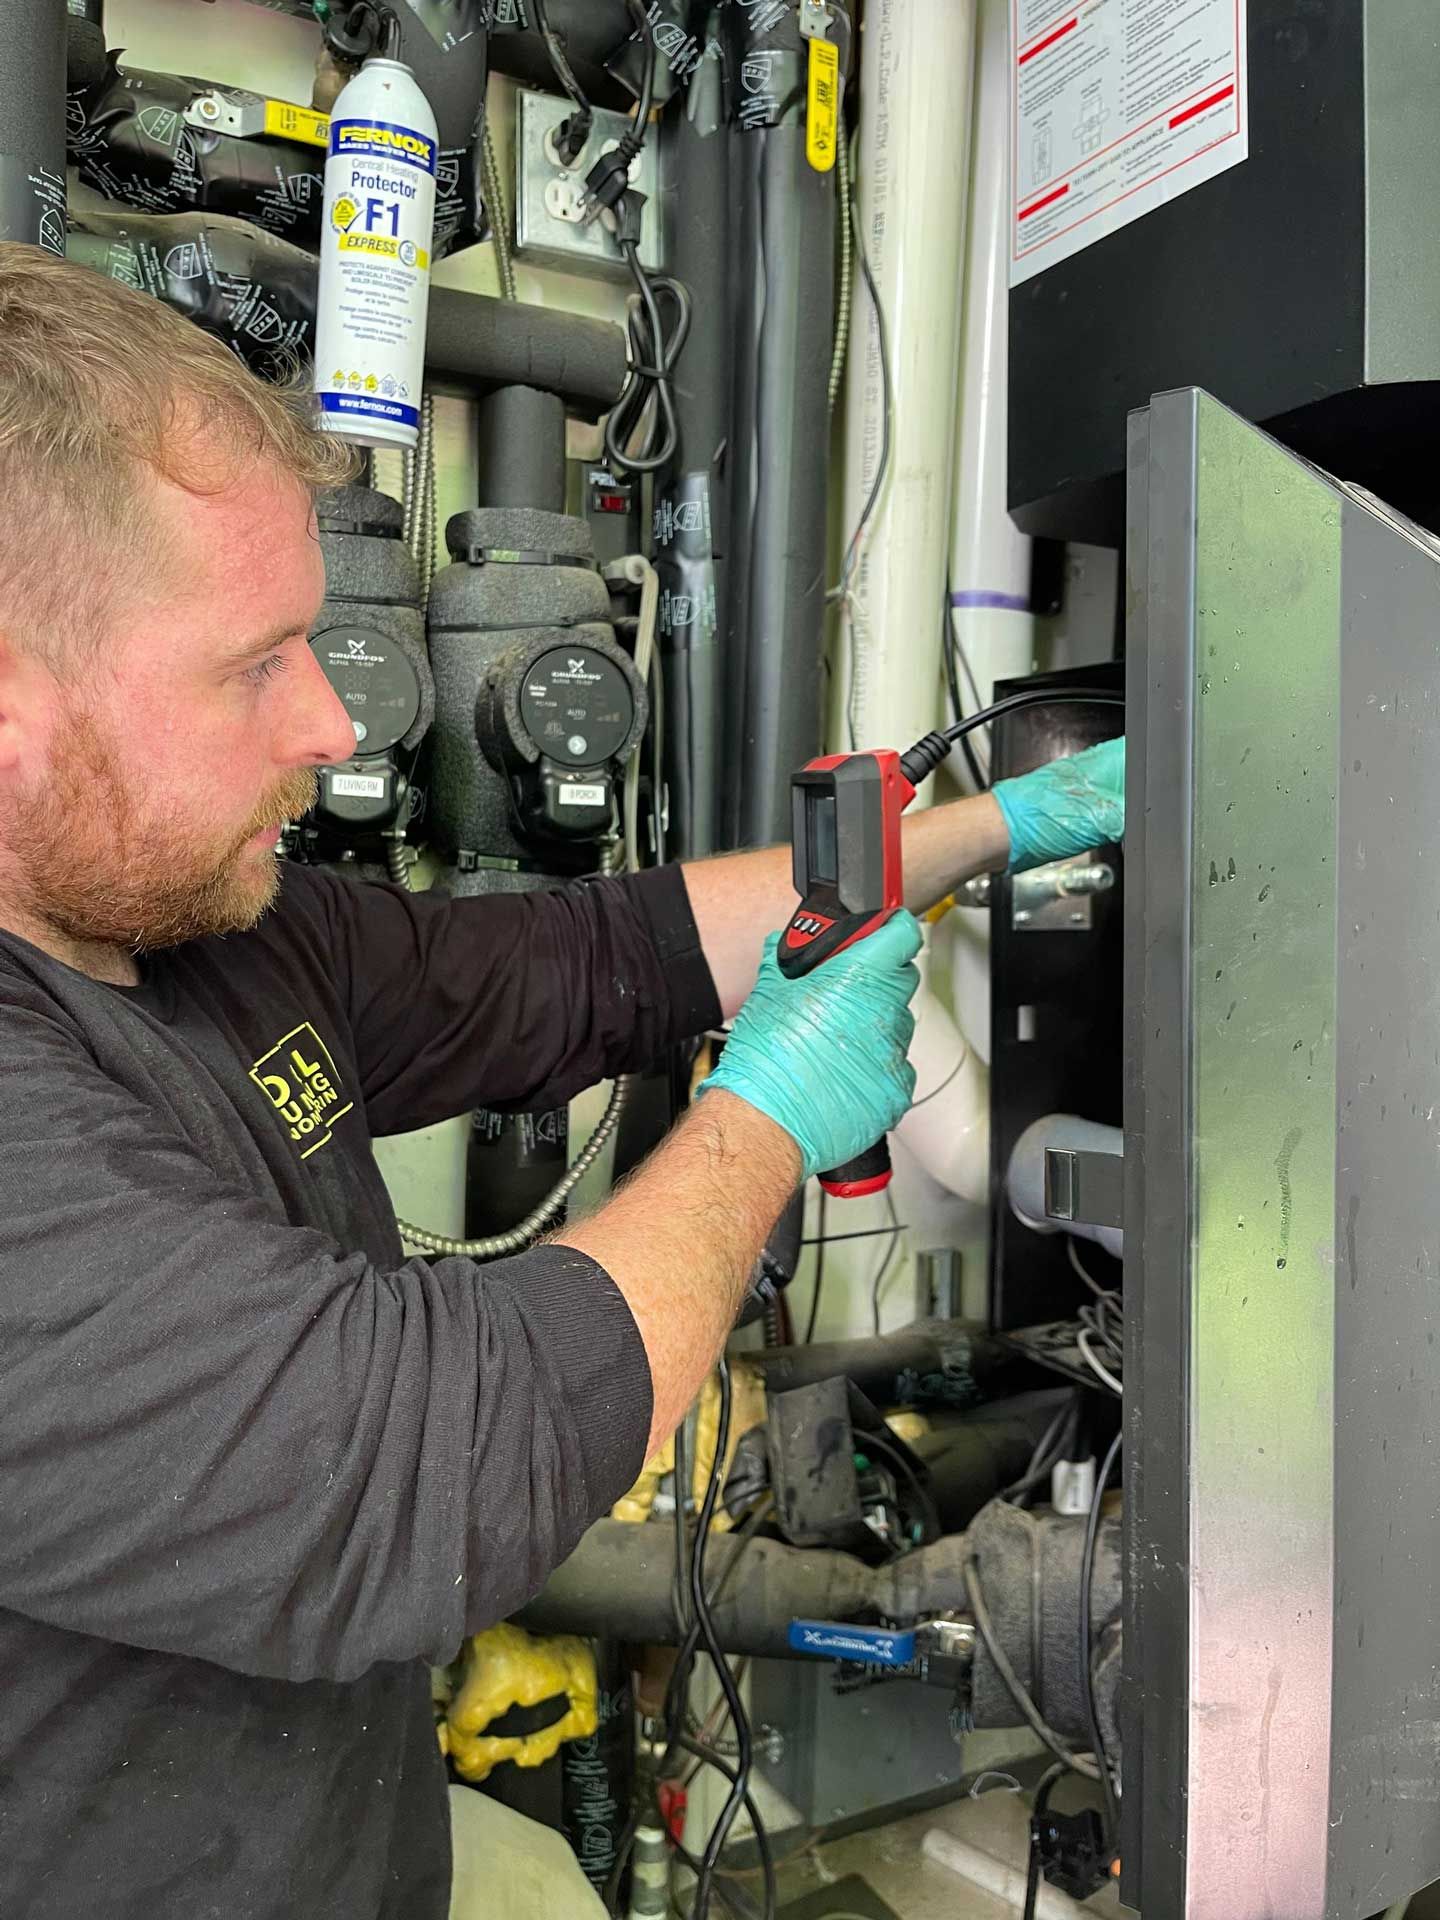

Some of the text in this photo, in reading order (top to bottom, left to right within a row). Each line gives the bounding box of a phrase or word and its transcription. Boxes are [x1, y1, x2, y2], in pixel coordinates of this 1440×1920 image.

[338, 126, 431, 160] FERNOX
[352, 158, 419, 184] Central Heating
[352, 171, 417, 200] Protector
[365, 197, 401, 237] F1
[347, 235, 397, 254] EXPRESS
[337, 397, 403, 417] www.fernox.com
[327, 651, 386, 663] GRUNDFOS
[550, 671, 602, 681] GRUNDFOS
[345, 692, 367, 702] AUTO
[567, 708, 587, 717] AUTO
[343, 779, 363, 791] LIVING
[367, 780, 378, 791] RM
